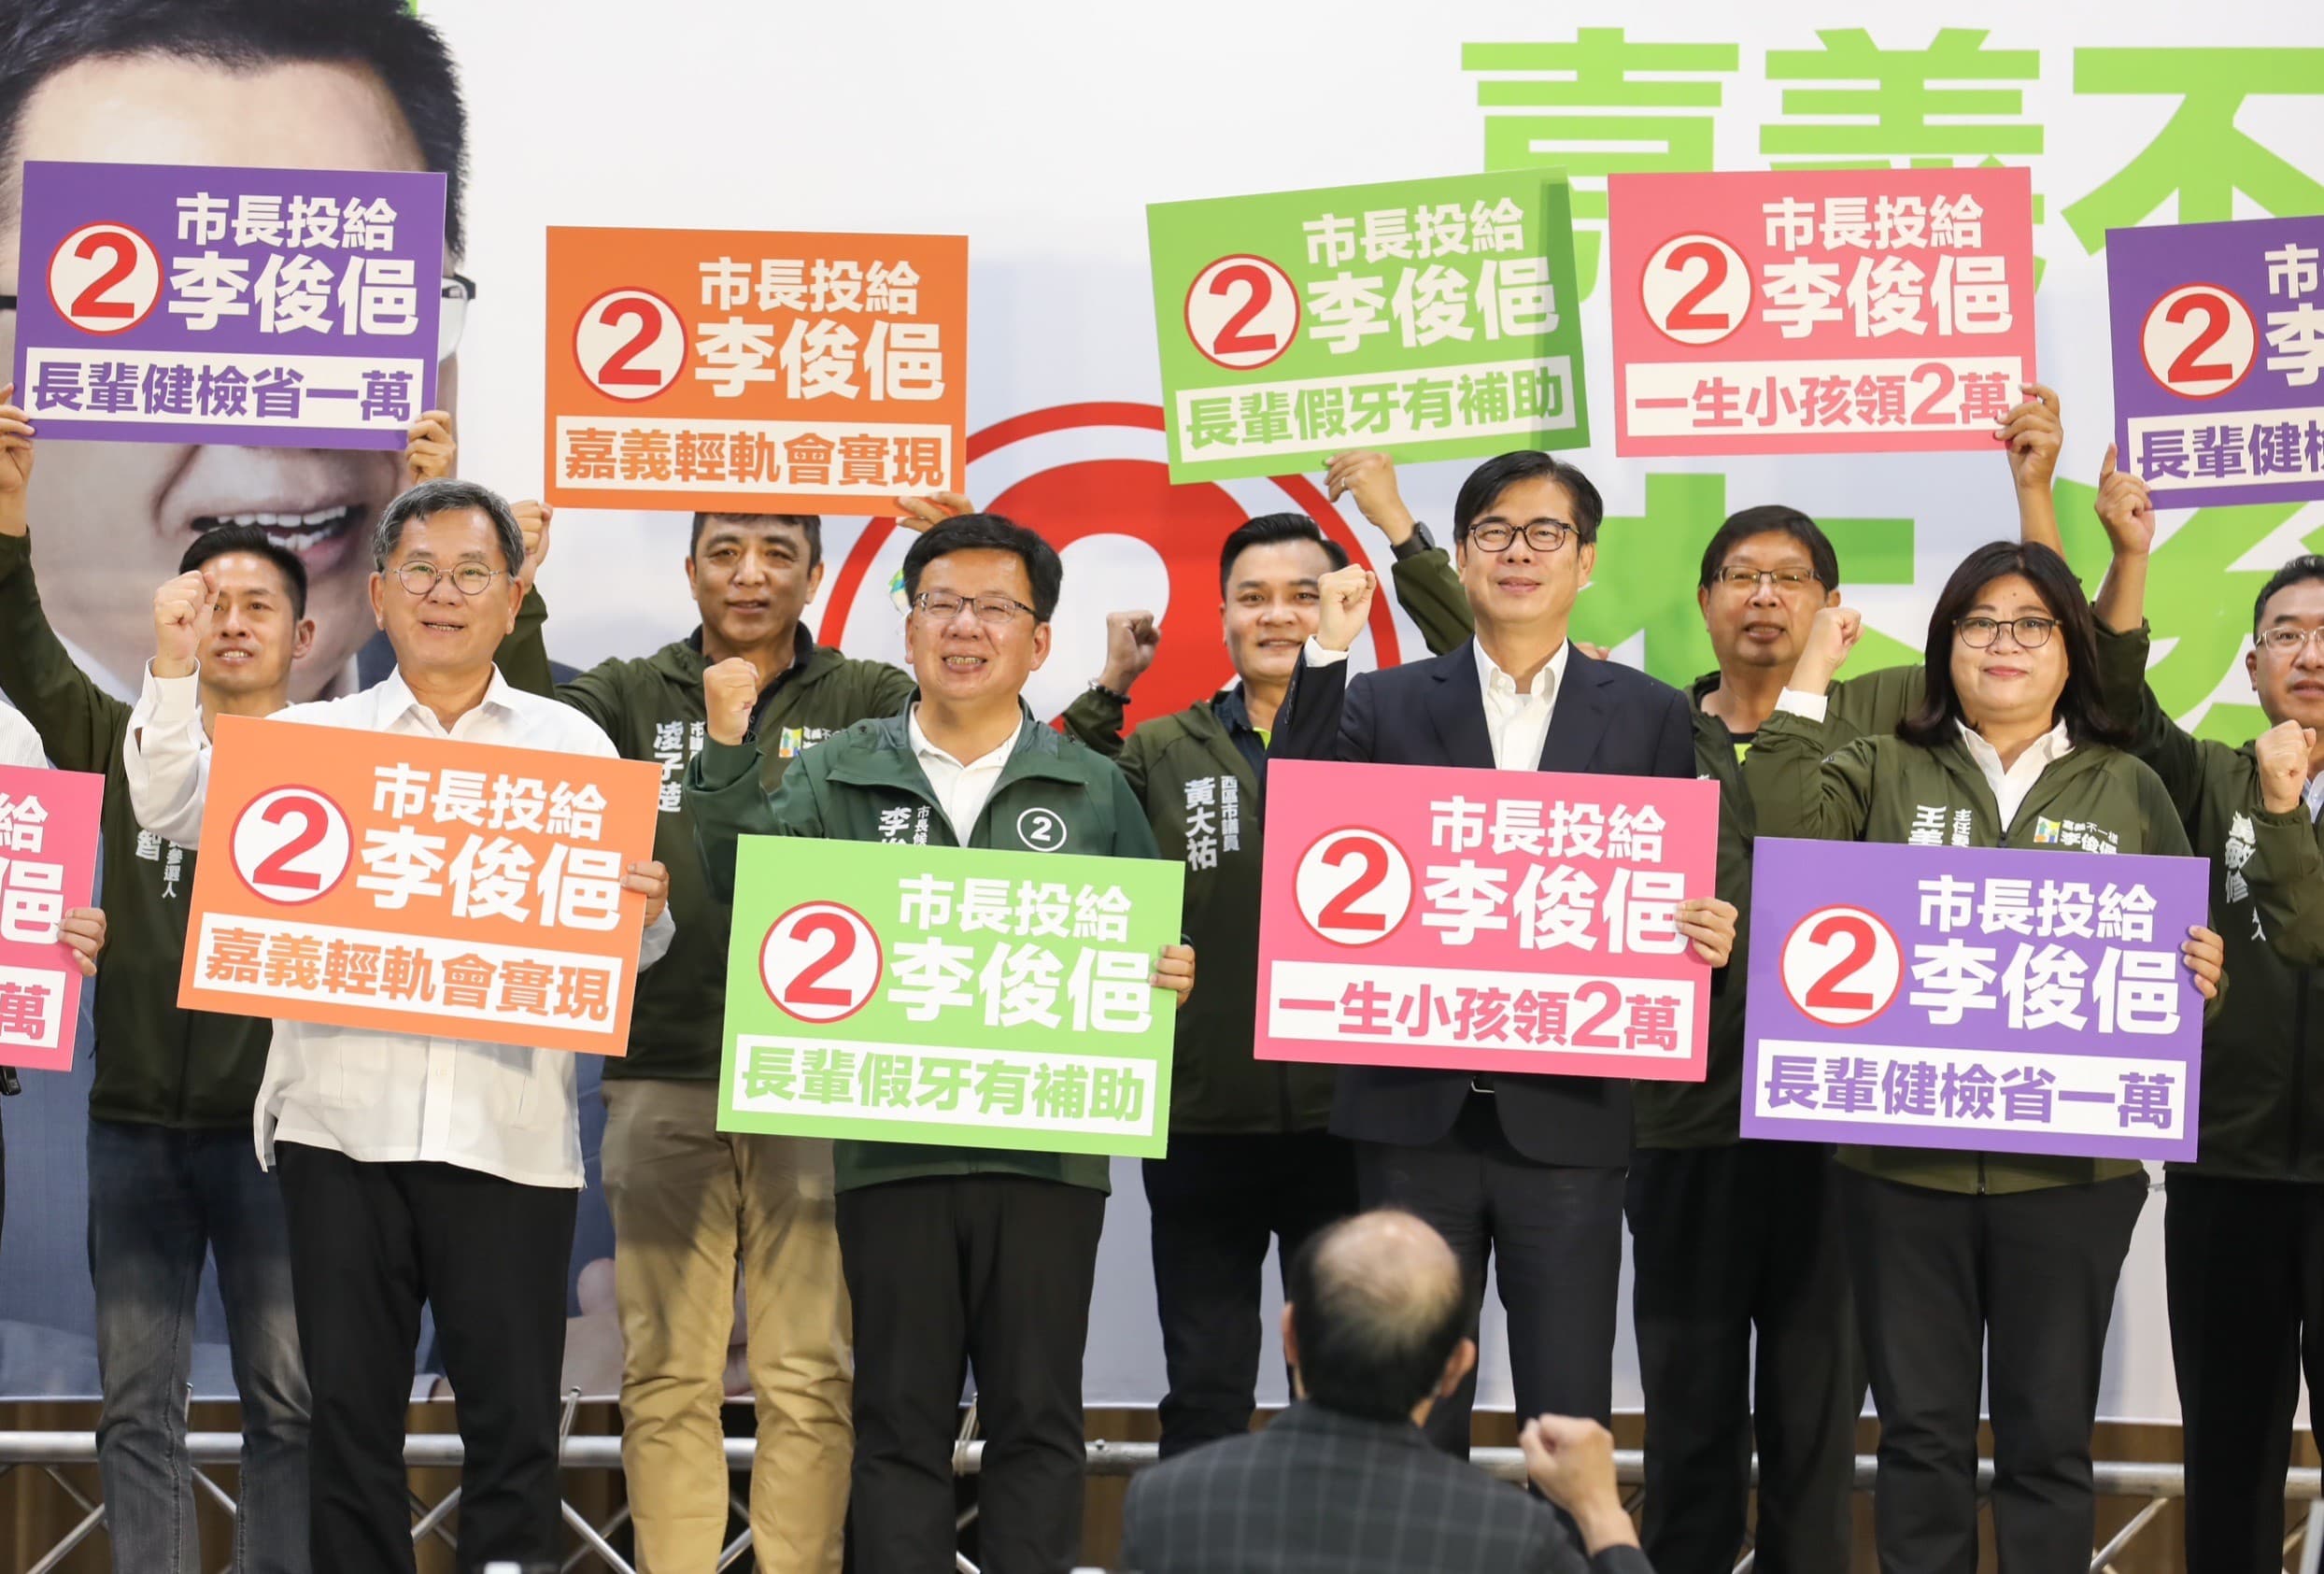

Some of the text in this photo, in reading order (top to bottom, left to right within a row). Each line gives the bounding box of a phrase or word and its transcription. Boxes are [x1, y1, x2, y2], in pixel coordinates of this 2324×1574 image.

[177, 191, 397, 251] 市長投給
[1303, 197, 1523, 268] 市長投給
[1763, 194, 1984, 251] 市長投給
[70, 232, 137, 319] 2
[168, 251, 418, 335] 李俊俋
[700, 257, 920, 315] 市長投給
[1209, 264, 1277, 355] 2
[1307, 257, 1560, 355] 李俊俋
[1665, 242, 1729, 331] 2
[1762, 254, 2013, 339] 李俊俋
[598, 297, 662, 386] 2
[695, 317, 945, 401] 李俊俋
[2165, 293, 2233, 383] 2
[32, 362, 413, 422] 長輩健檢省一萬
[1185, 366, 1563, 450] 長輩假牙有補助
[1635, 362, 2010, 428] 一生小孩領2萬
[565, 427, 943, 487] 嘉義輕軌會實現
[252, 796, 329, 891] 2
[373, 762, 607, 841] 市長投給
[878, 806, 912, 844] 李
[1184, 777, 1217, 872] 黃大祐
[1430, 795, 1666, 863] 市長投給
[356, 826, 622, 931] 李俊俋
[899, 873, 1132, 943] 市長投給
[1318, 836, 1389, 931] 2
[1421, 858, 1688, 955] 李俊俋
[1917, 874, 2157, 943] 市長投給
[205, 928, 610, 1022] 嘉義輕軌會實現
[784, 912, 857, 1007] 2
[887, 936, 1153, 1034] 李俊俋
[1805, 915, 1877, 1011] 2
[1909, 938, 2180, 1034] 李俊俋
[1279, 980, 1680, 1051] 一生小孩領2萬
[742, 1045, 1145, 1122] 長輩假牙有補助
[1764, 1054, 2175, 1129] 長輩健檢省一萬
